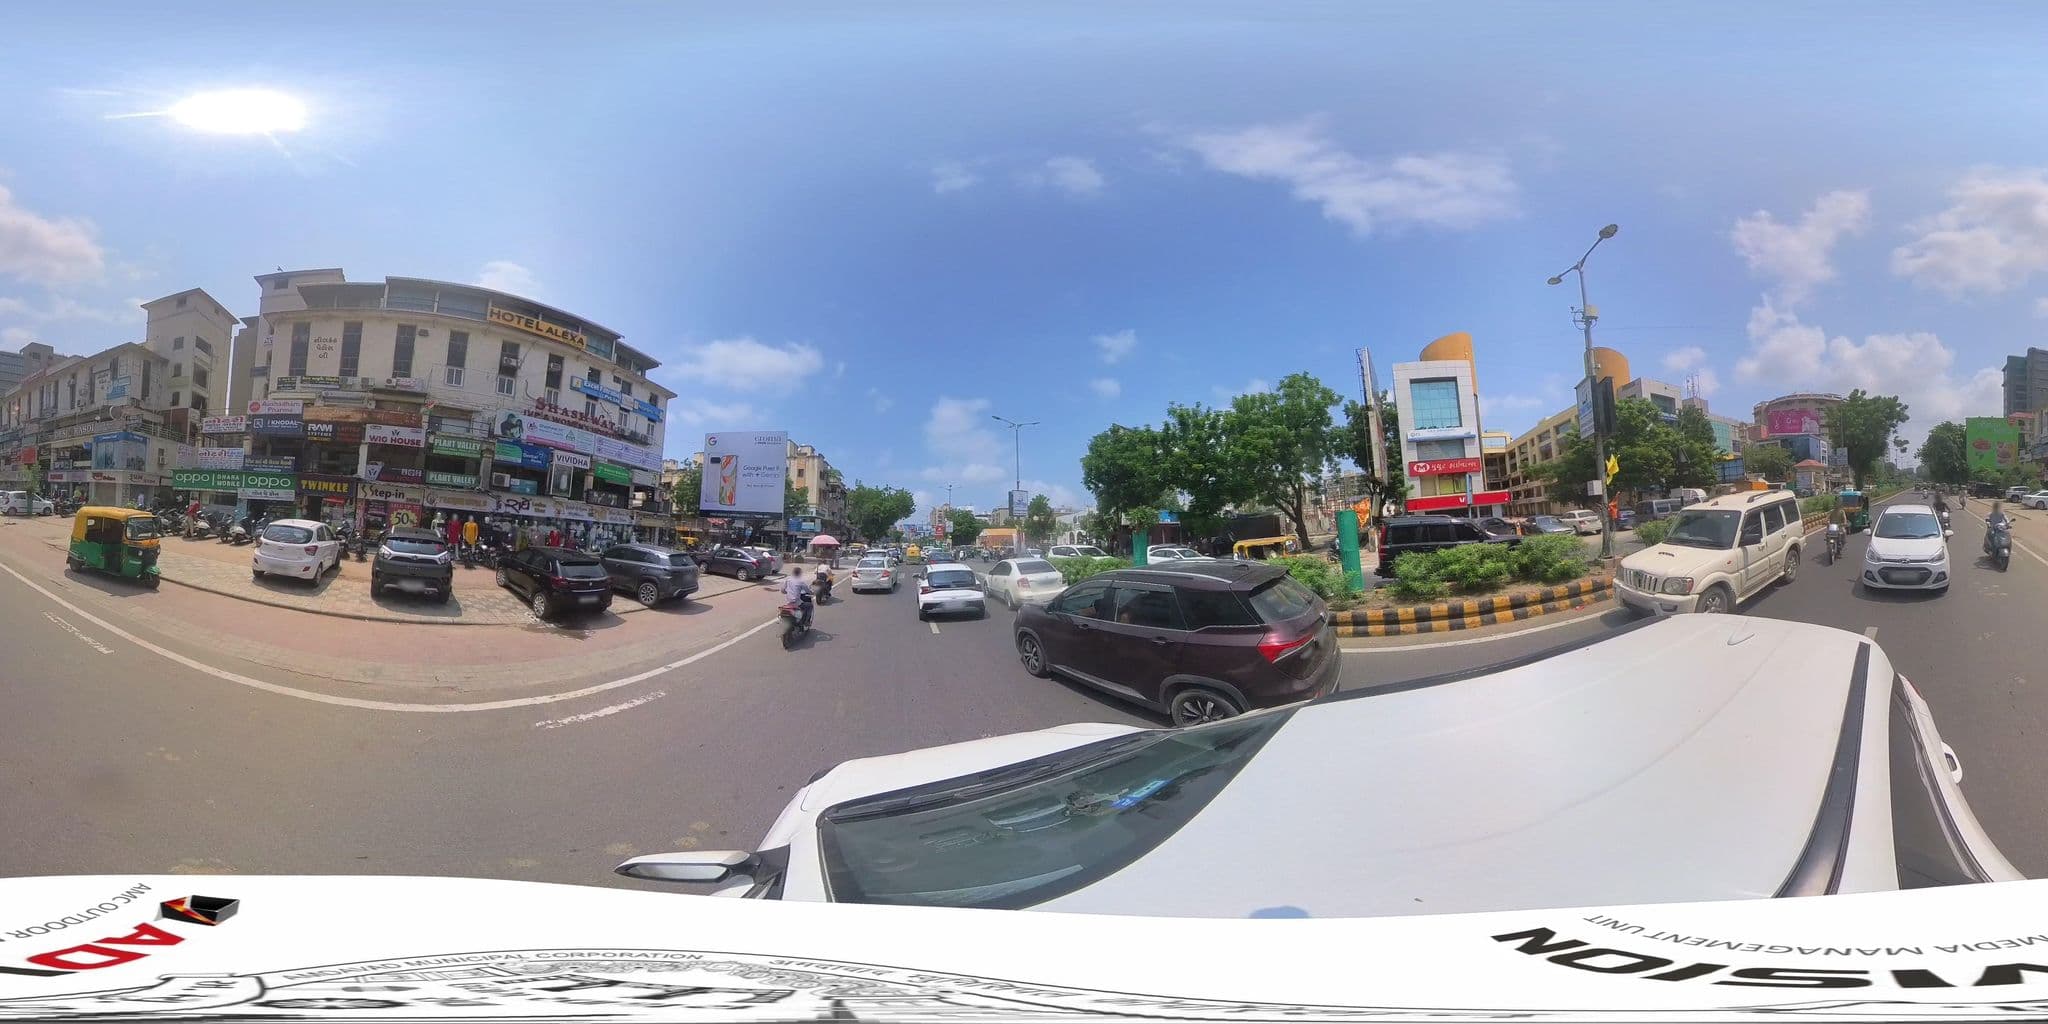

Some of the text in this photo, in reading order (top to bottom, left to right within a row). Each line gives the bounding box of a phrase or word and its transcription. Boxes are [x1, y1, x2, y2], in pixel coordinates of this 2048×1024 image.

[490, 308, 586, 348] HOTEL ALEXA
[535, 397, 616, 432] SHASHWAT
[308, 424, 333, 432] RAM
[369, 435, 422, 446] WIG HOUSE
[434, 439, 480, 450] PLANT VALLEY
[556, 454, 589, 467] VIVIDHA
[176, 473, 209, 483] oppo
[248, 476, 291, 488] oppo
[430, 473, 476, 484] PLANT VALLEY
[301, 480, 349, 492] TWINKLE
[369, 485, 405, 499] Step-in
